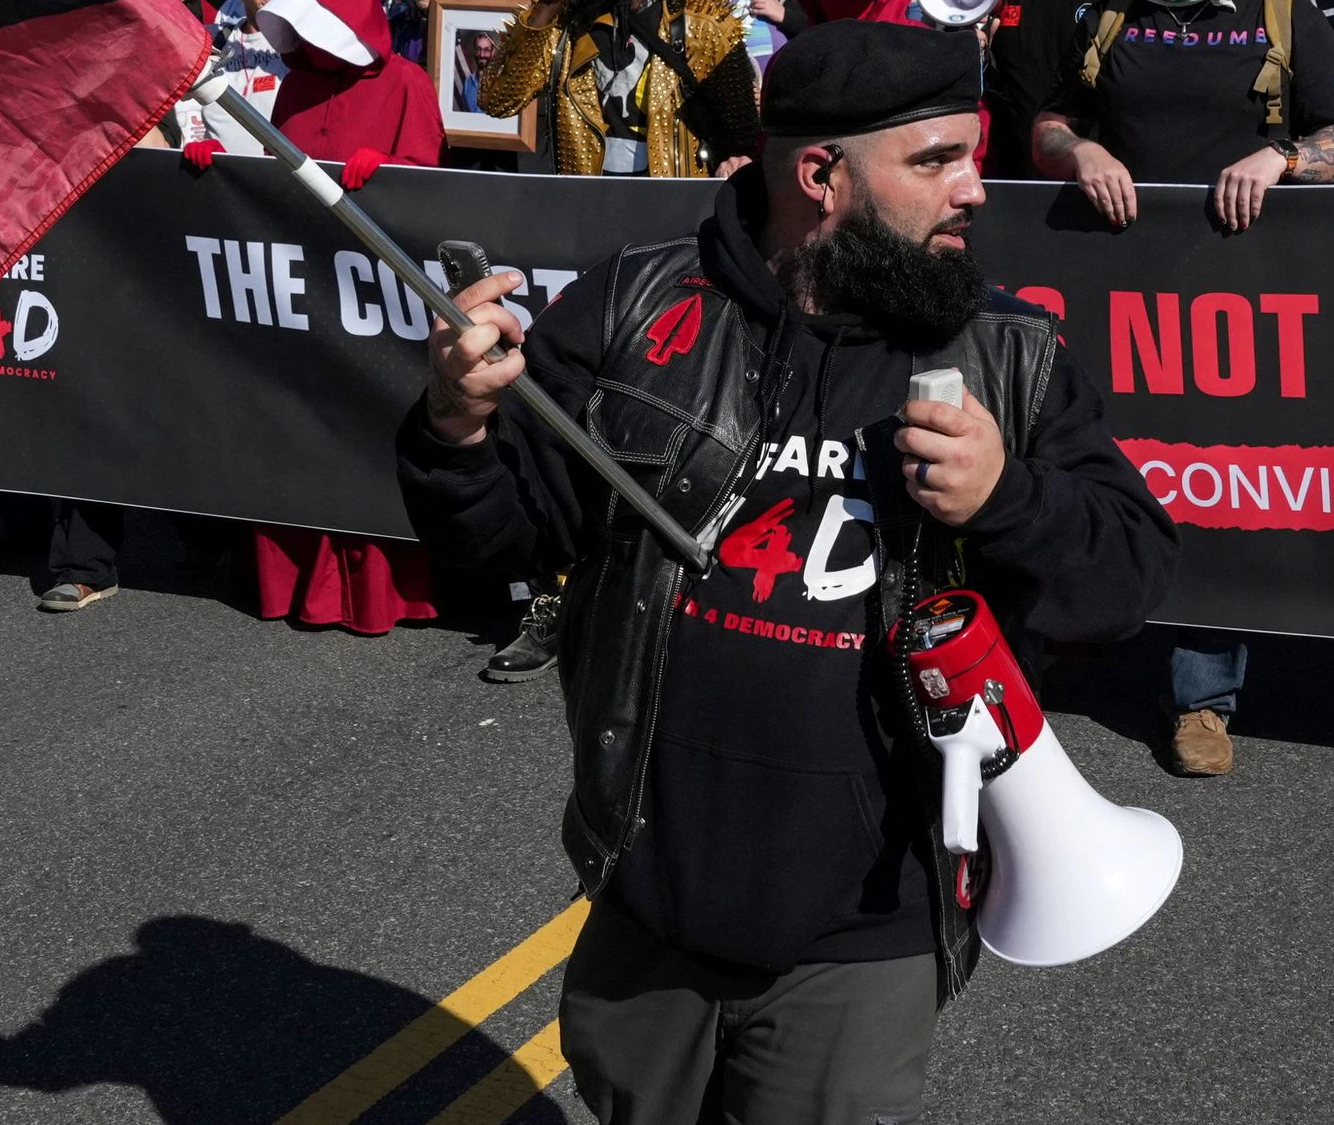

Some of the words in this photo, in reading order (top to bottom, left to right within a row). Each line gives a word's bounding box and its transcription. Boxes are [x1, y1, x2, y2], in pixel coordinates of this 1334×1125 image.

[1125, 27, 1267, 46] REEDUMB
[3, 254, 45, 281] RE
[185, 235, 310, 331] THE
[1108, 290, 1319, 399] NOT
[704, 608, 718, 625] 4
[724, 612, 866, 650] DEMOCRACY
